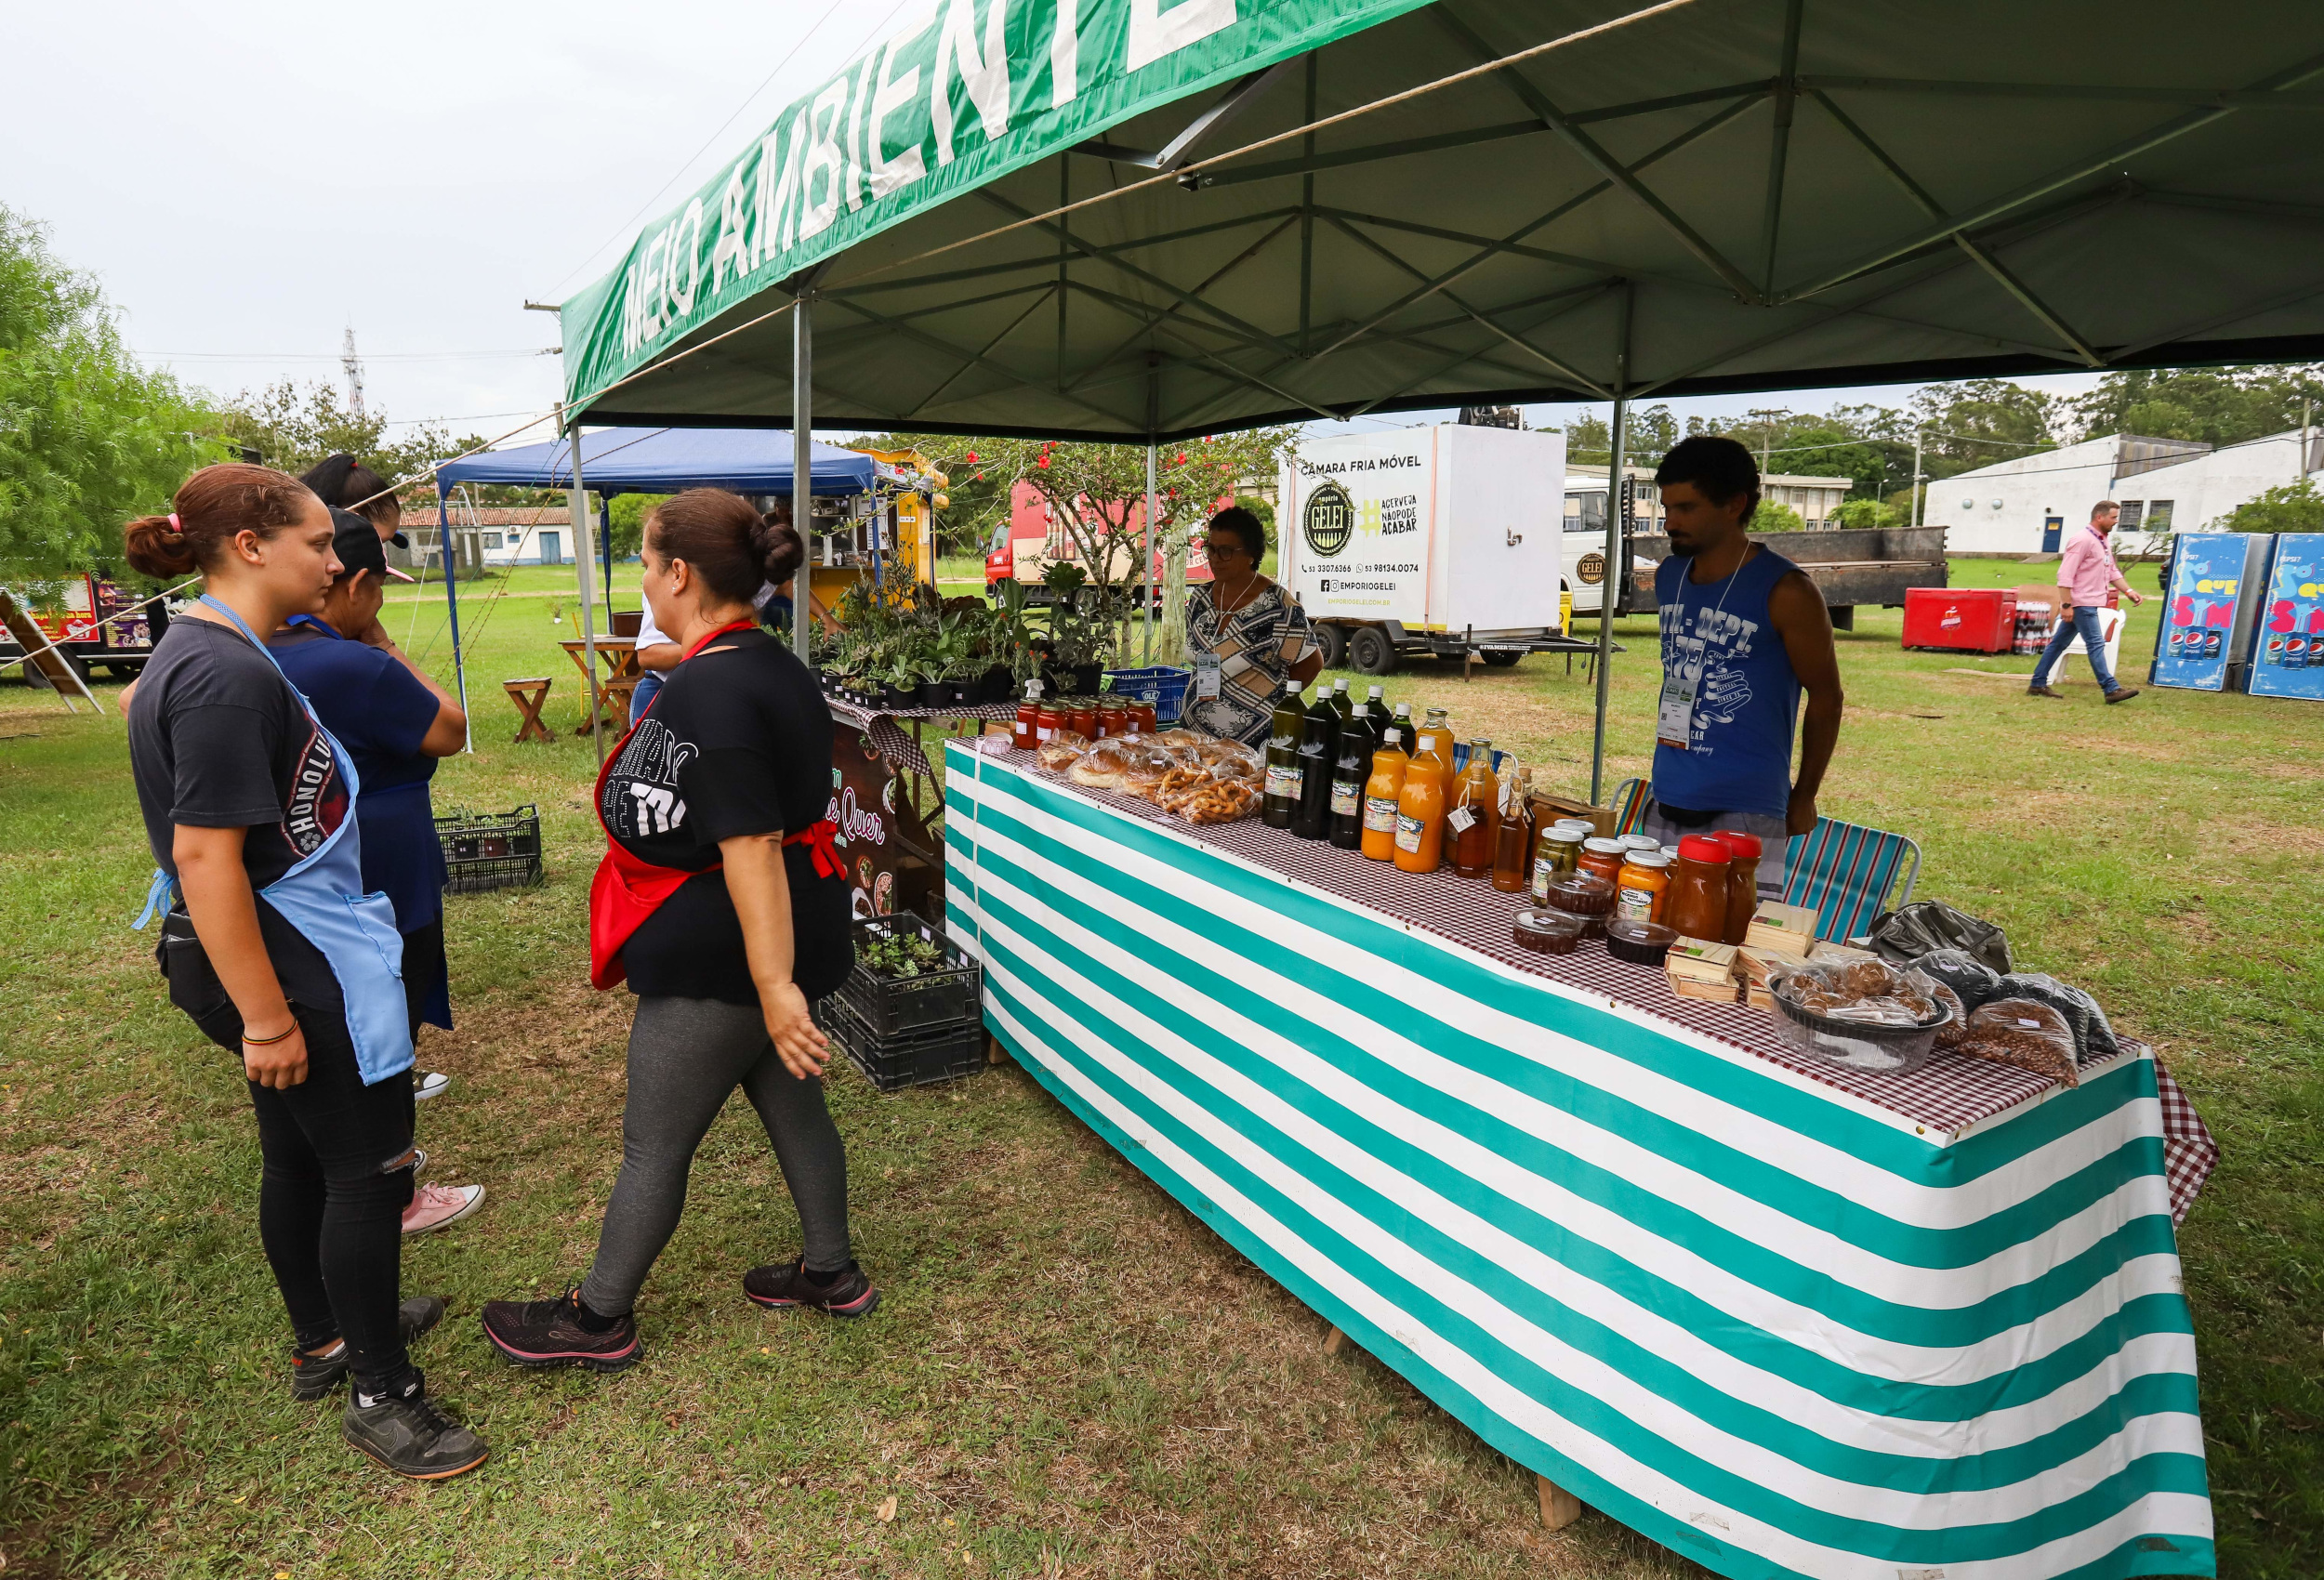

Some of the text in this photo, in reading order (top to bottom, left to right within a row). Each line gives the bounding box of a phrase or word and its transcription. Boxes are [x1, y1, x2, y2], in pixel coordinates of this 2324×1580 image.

[622, 195, 704, 360] MEIO
[1351, 460, 1376, 472] FRIA
[1380, 454, 1421, 469] MÓVEL
[1312, 505, 1344, 530] GELEI
[1381, 518, 1418, 536] ACABAR
[1374, 563, 1419, 573] 98134.0074
[1582, 561, 1603, 573] GELEI
[1340, 582, 1396, 591] EMPORIOGELEI
[2196, 579, 2238, 596] QUE
[1695, 606, 1759, 652] DEPT.
[1690, 743, 1714, 757] ompany
[842, 786, 885, 846] Quer
